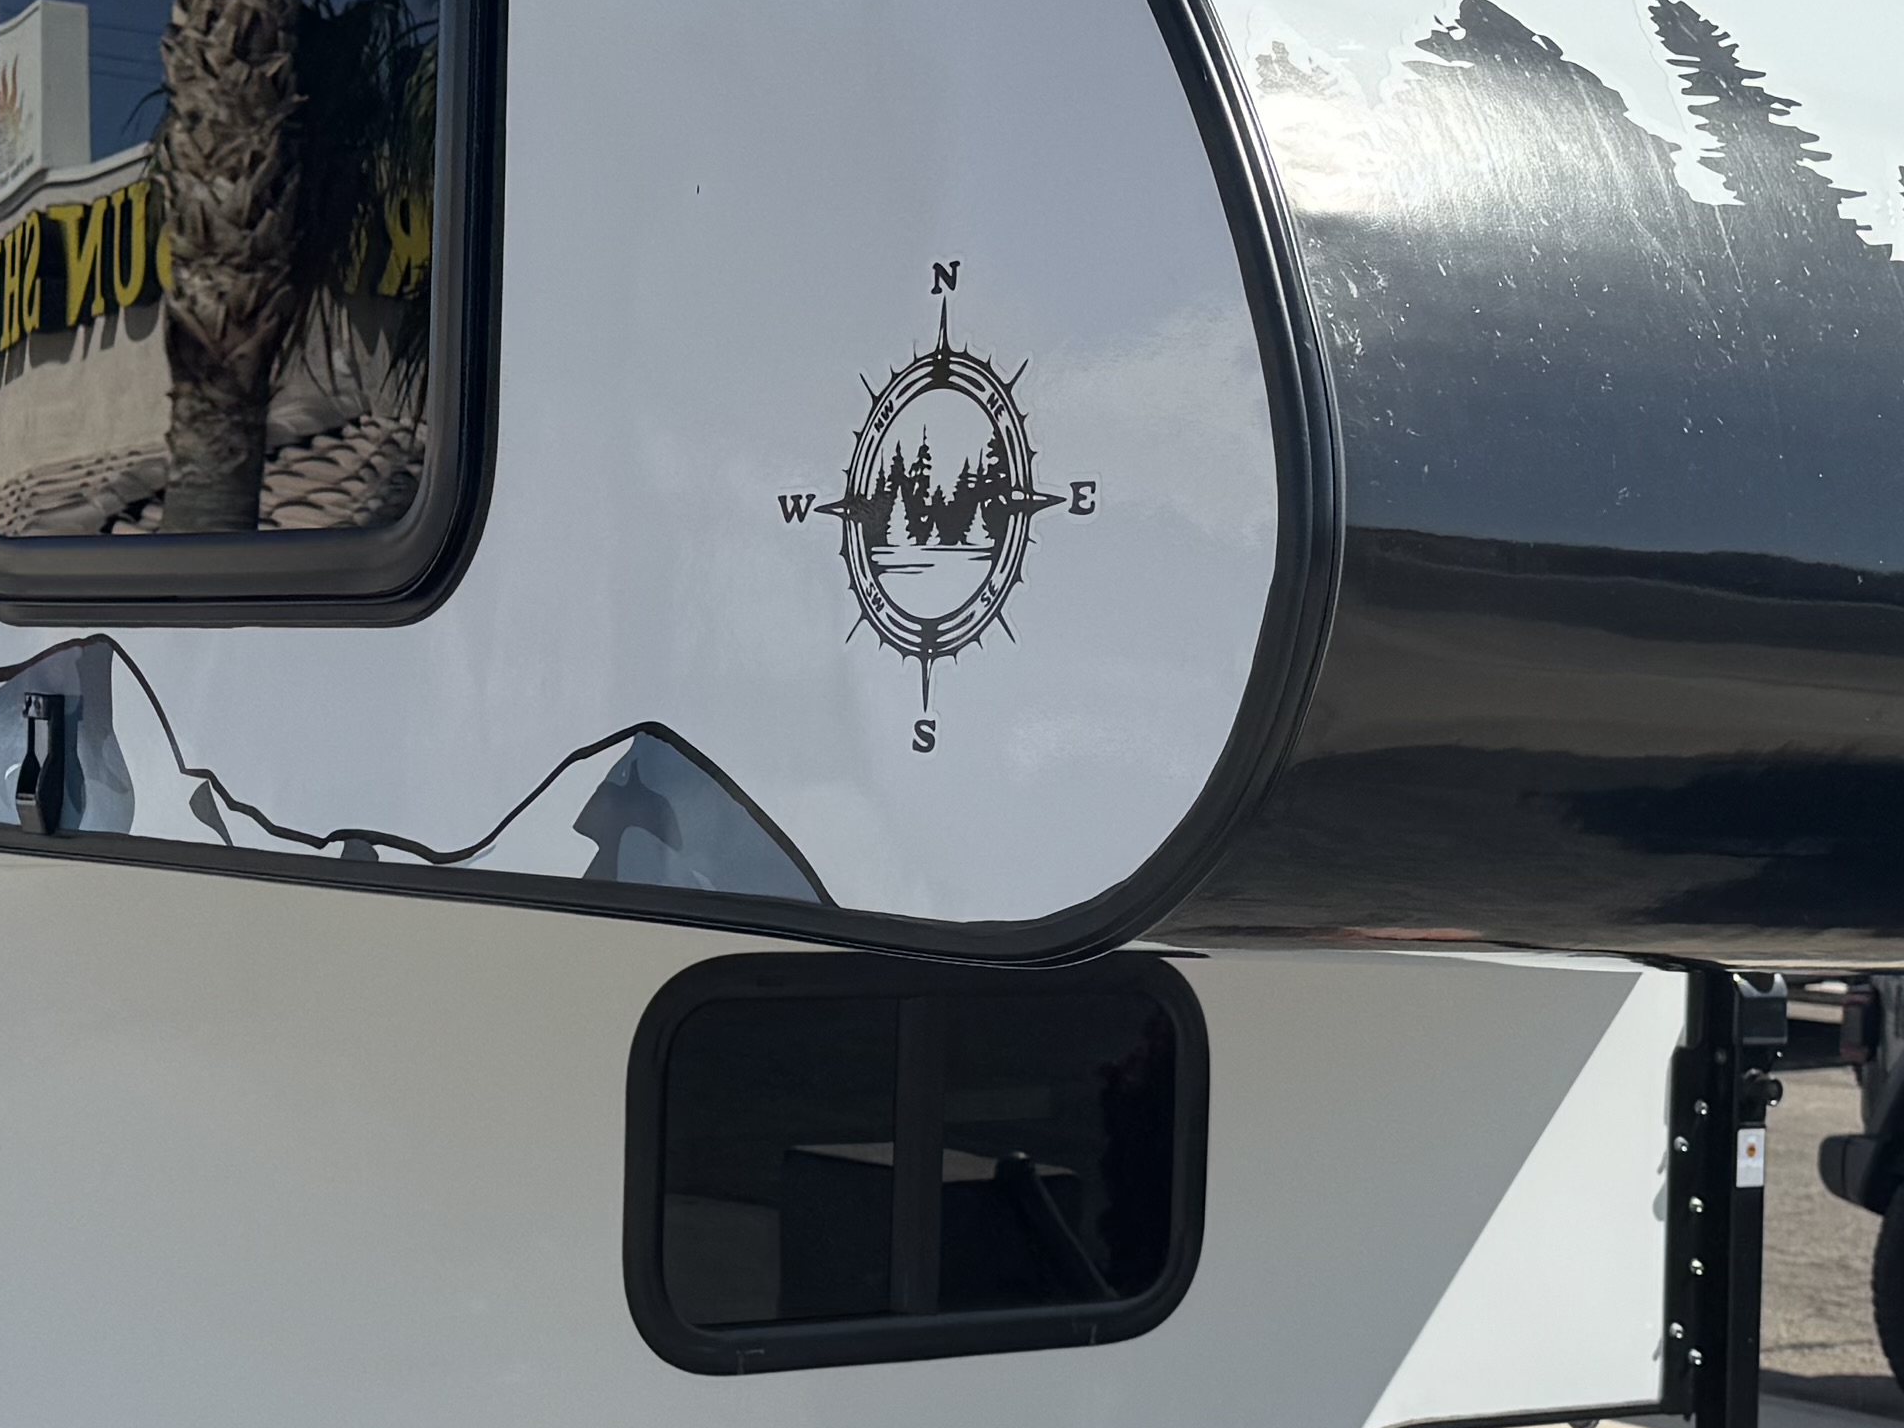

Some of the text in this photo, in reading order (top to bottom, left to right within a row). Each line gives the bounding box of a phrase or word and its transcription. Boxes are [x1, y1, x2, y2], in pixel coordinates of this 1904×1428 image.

[931, 261, 961, 295] N
[778, 494, 816, 523] W
[1069, 481, 1096, 516] E
[980, 580, 999, 608] SE
[912, 720, 937, 753] S
